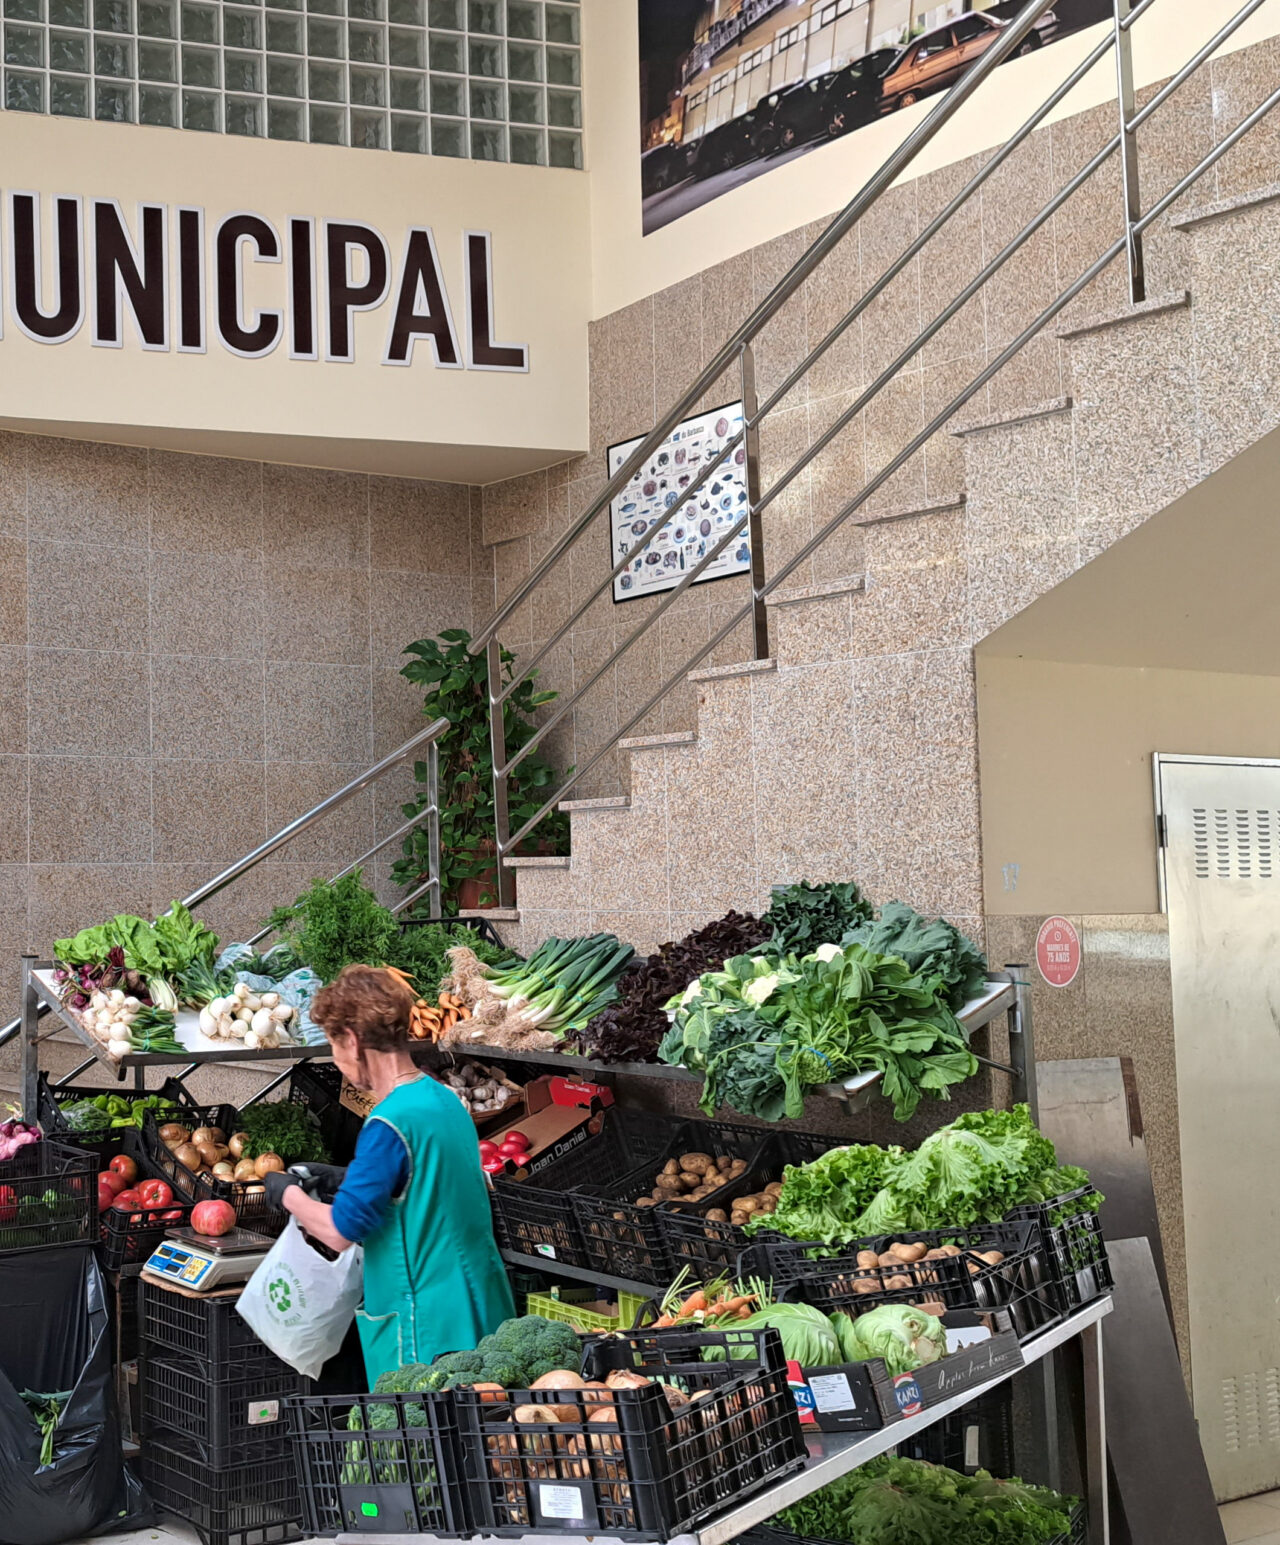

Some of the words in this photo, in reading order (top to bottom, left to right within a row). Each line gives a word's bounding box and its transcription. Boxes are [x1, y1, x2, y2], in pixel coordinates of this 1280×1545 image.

[1048, 952, 1054, 962] 75
[530, 1154, 554, 1174] Joan
[554, 1127, 587, 1157] Daniel
